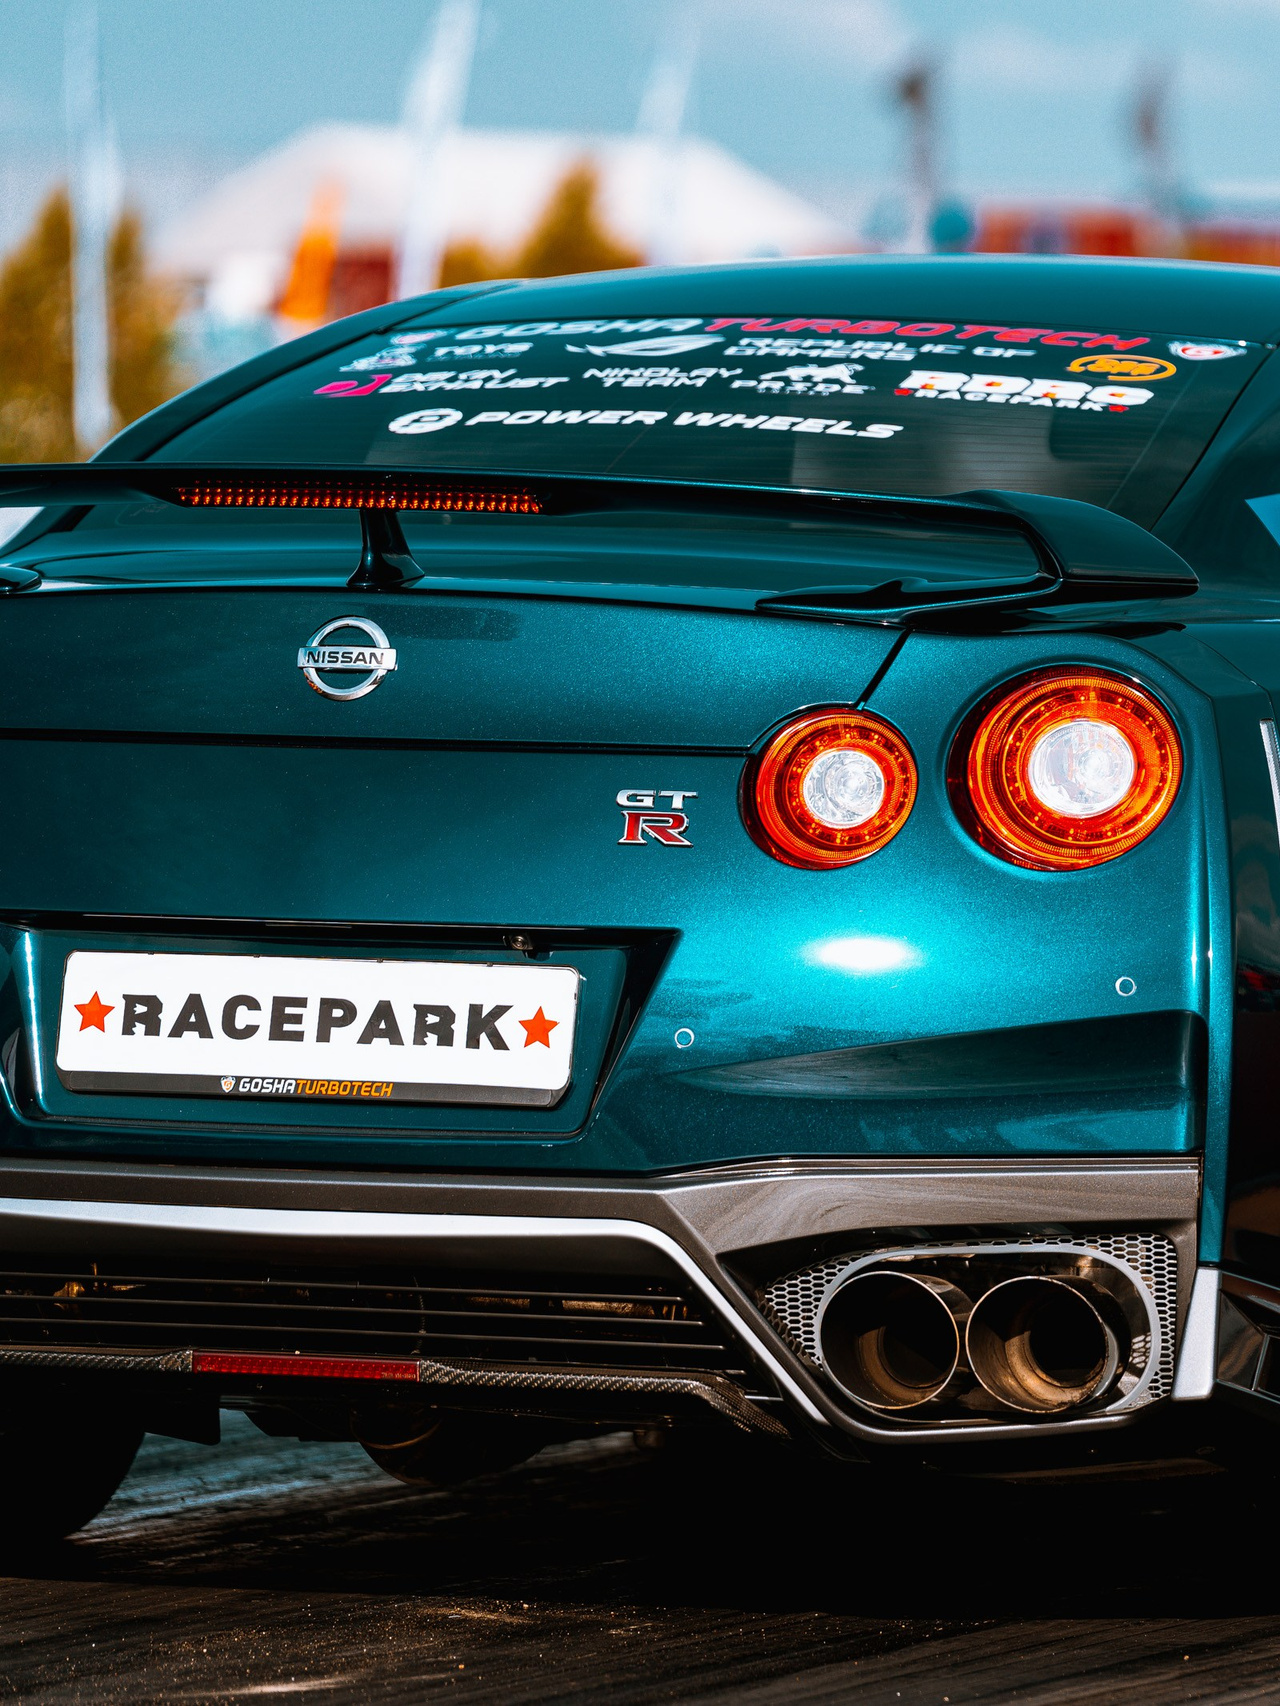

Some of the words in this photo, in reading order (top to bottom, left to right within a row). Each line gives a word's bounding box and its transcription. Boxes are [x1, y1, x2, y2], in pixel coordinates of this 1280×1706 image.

[972, 346, 1037, 358] OF
[583, 366, 743, 379] NIKOLAY
[602, 376, 707, 388] TEAM
[379, 376, 570, 394] EXHAUST
[914, 389, 1104, 413] RACEPARK
[464, 409, 668, 427] POWER
[673, 411, 904, 439] WHEELS
[306, 650, 385, 666] NISSAN
[616, 788, 699, 811] GT
[617, 810, 694, 848] R
[121, 992, 515, 1052] RACEPARK
[238, 1077, 394, 1098] GOSHATURBOTECH
